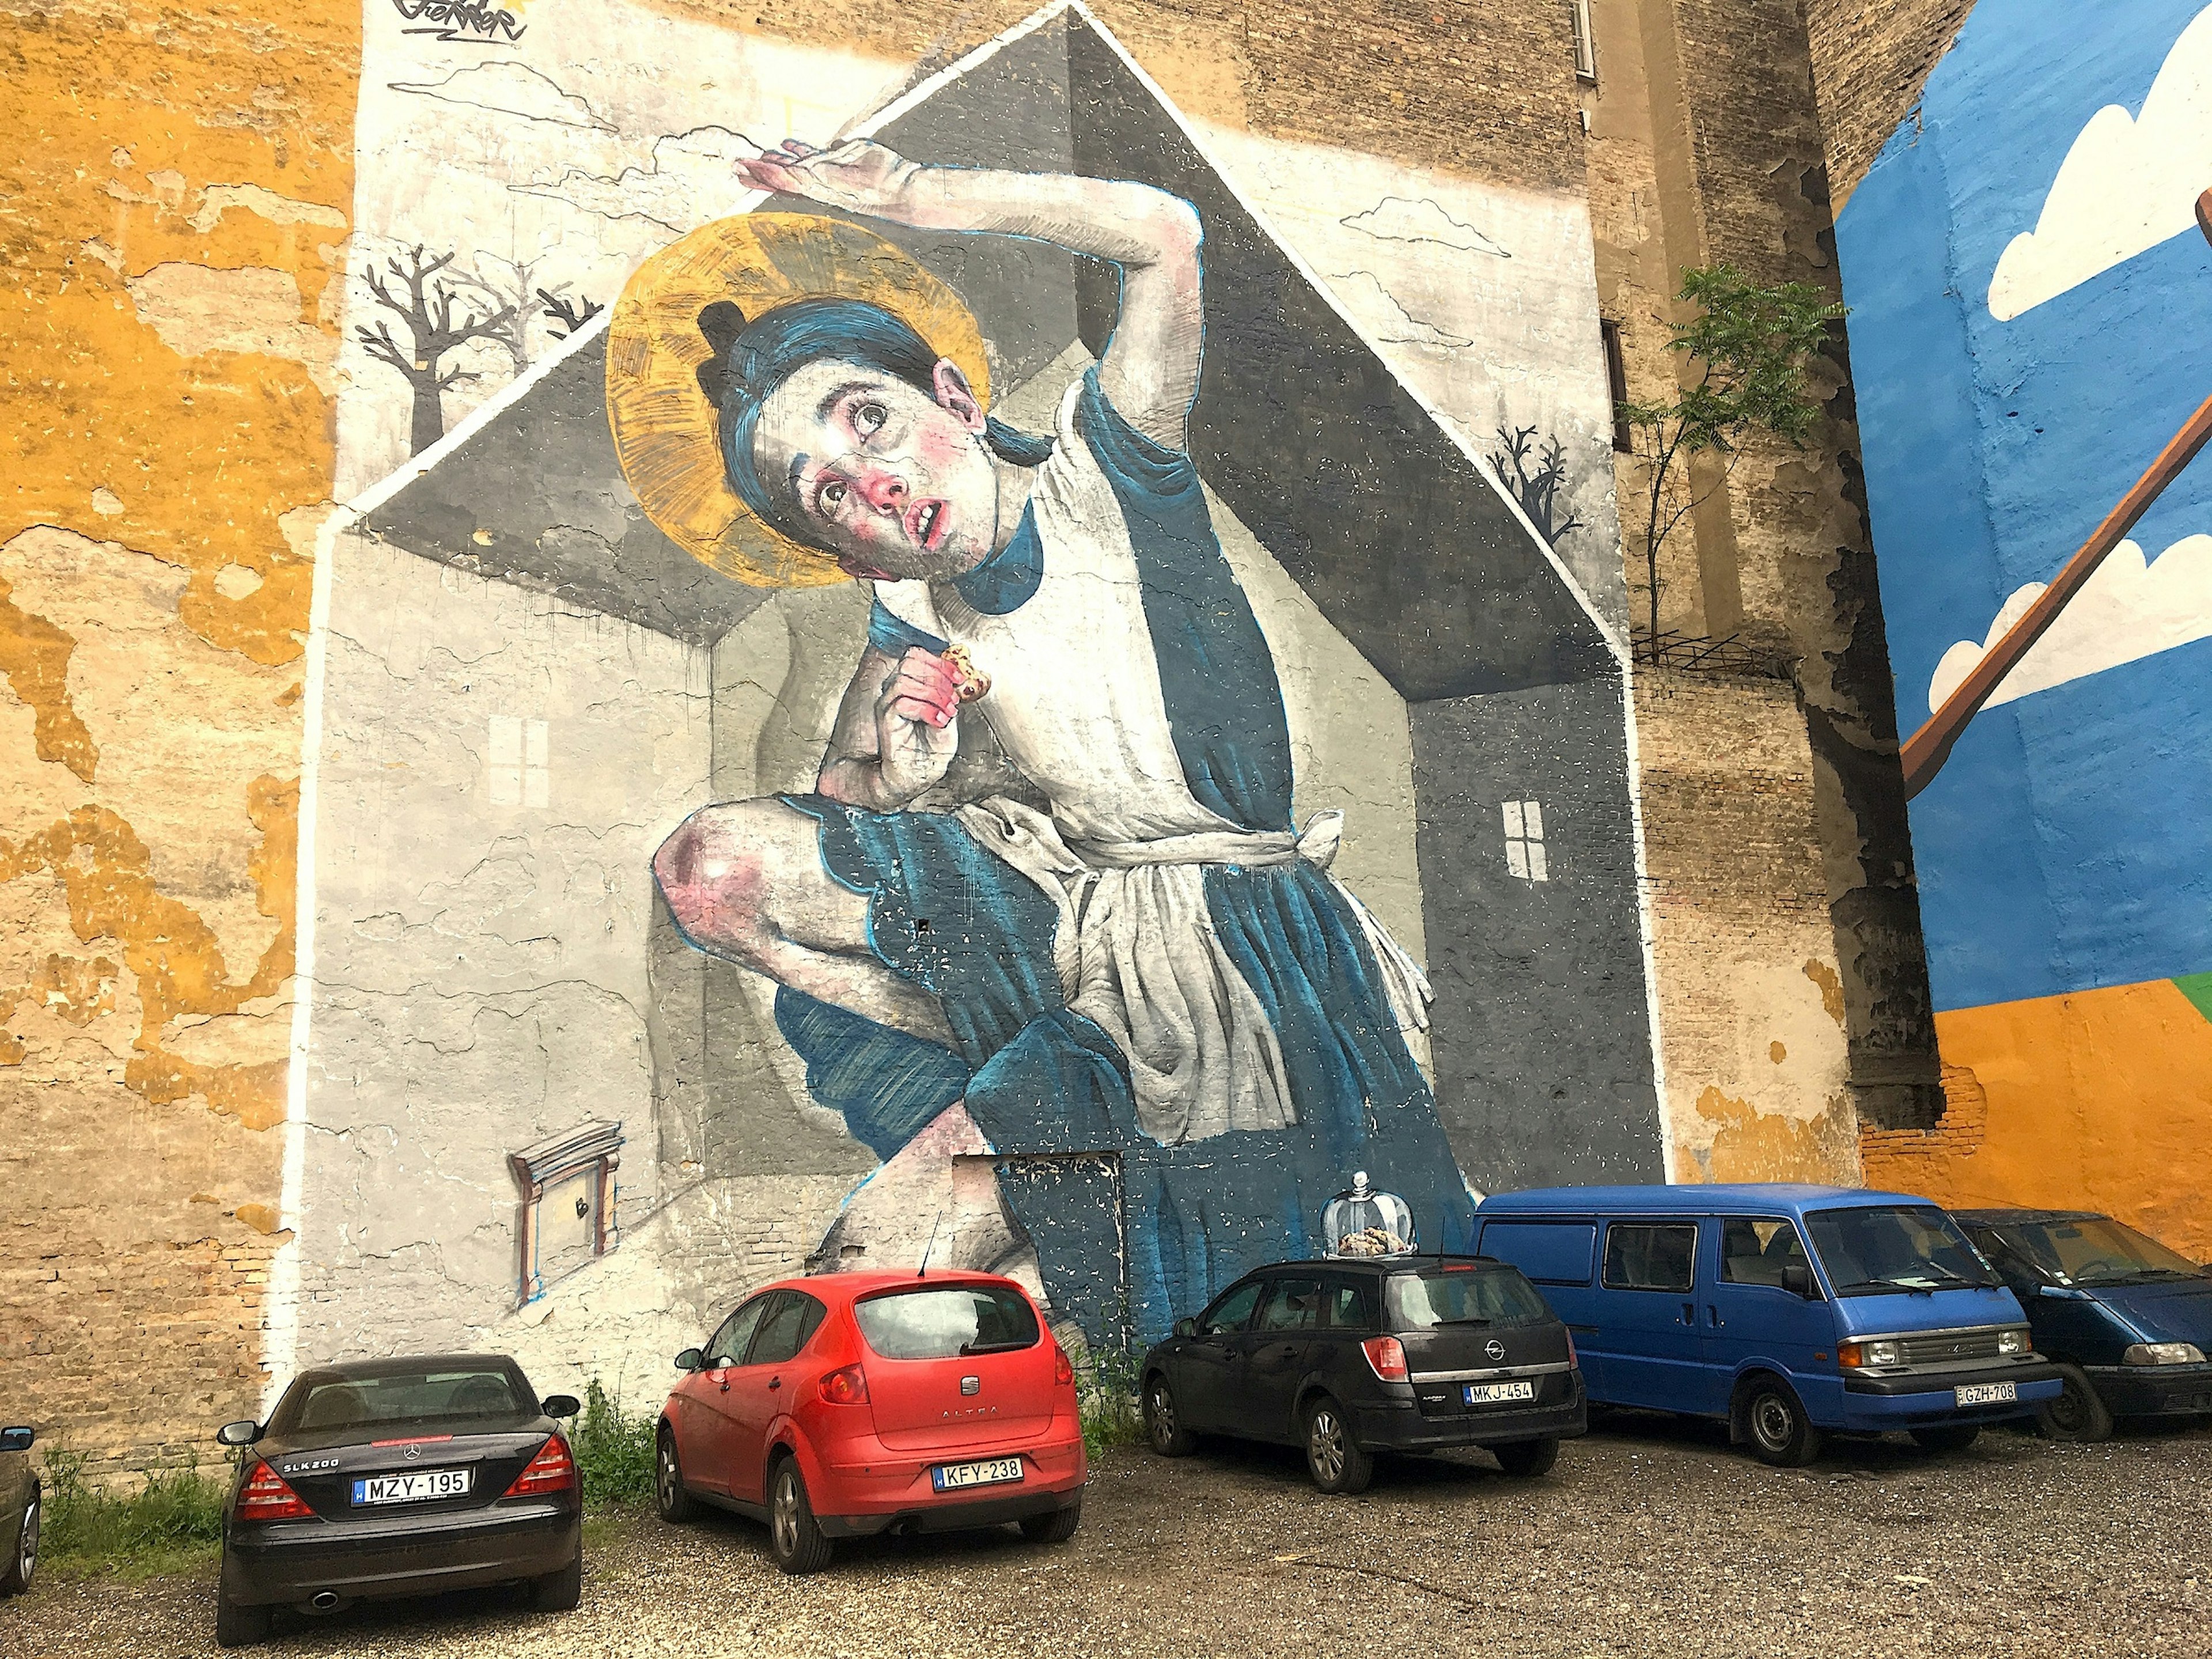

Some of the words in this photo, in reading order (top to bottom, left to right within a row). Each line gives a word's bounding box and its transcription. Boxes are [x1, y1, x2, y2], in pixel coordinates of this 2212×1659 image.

[1474, 1384, 1529, 1401] MKJ-454
[1966, 1385, 2013, 1402] GZH-708
[947, 1461, 1018, 1484] KFY-238
[370, 1473, 463, 1499] MZY-195
